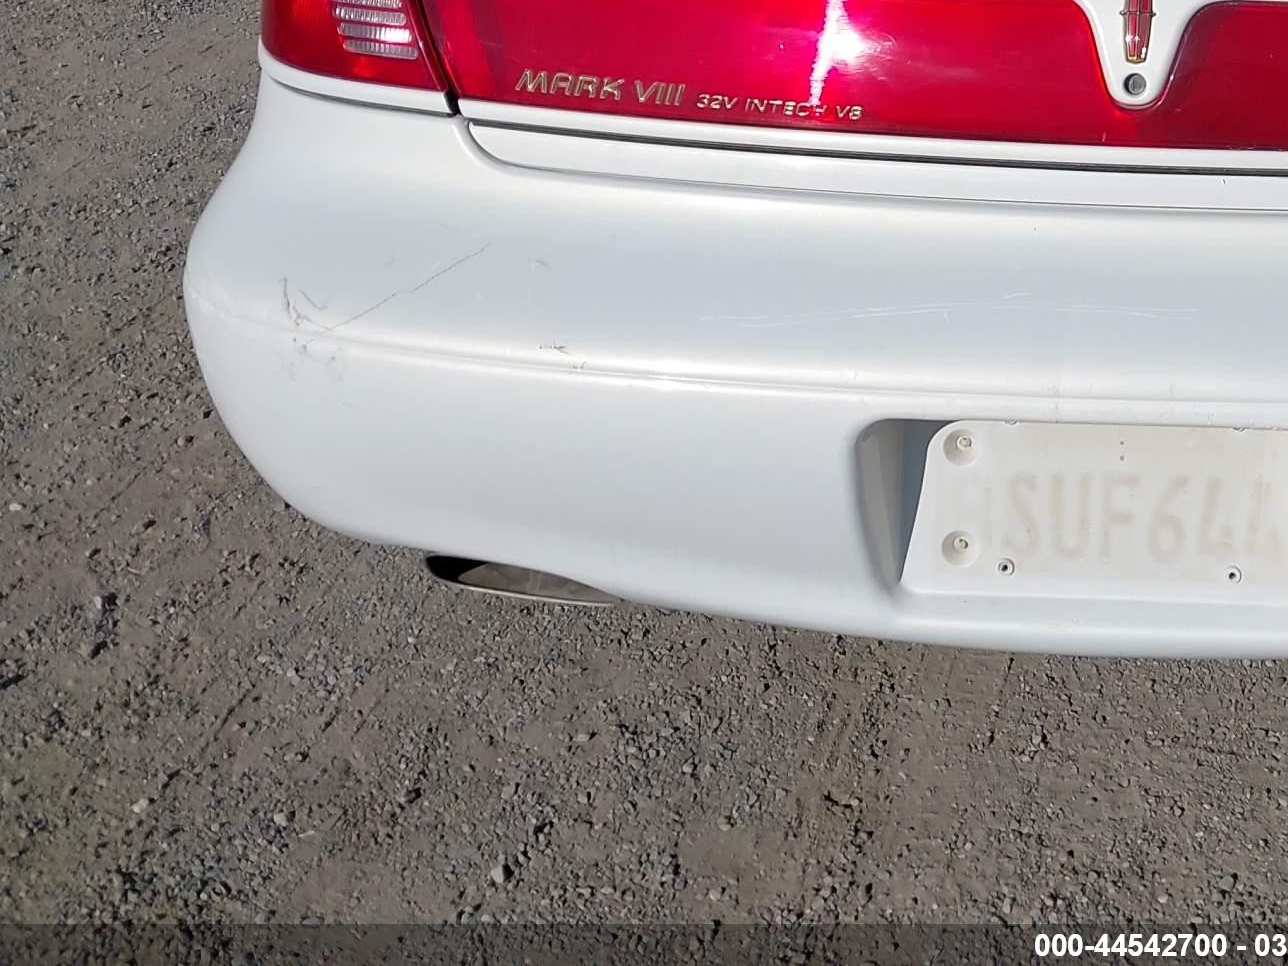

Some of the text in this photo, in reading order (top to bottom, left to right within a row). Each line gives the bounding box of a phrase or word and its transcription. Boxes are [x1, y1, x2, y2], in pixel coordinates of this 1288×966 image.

[514, 68, 686, 106] MARK VIII
[696, 94, 863, 120] 32V INTECH V8
